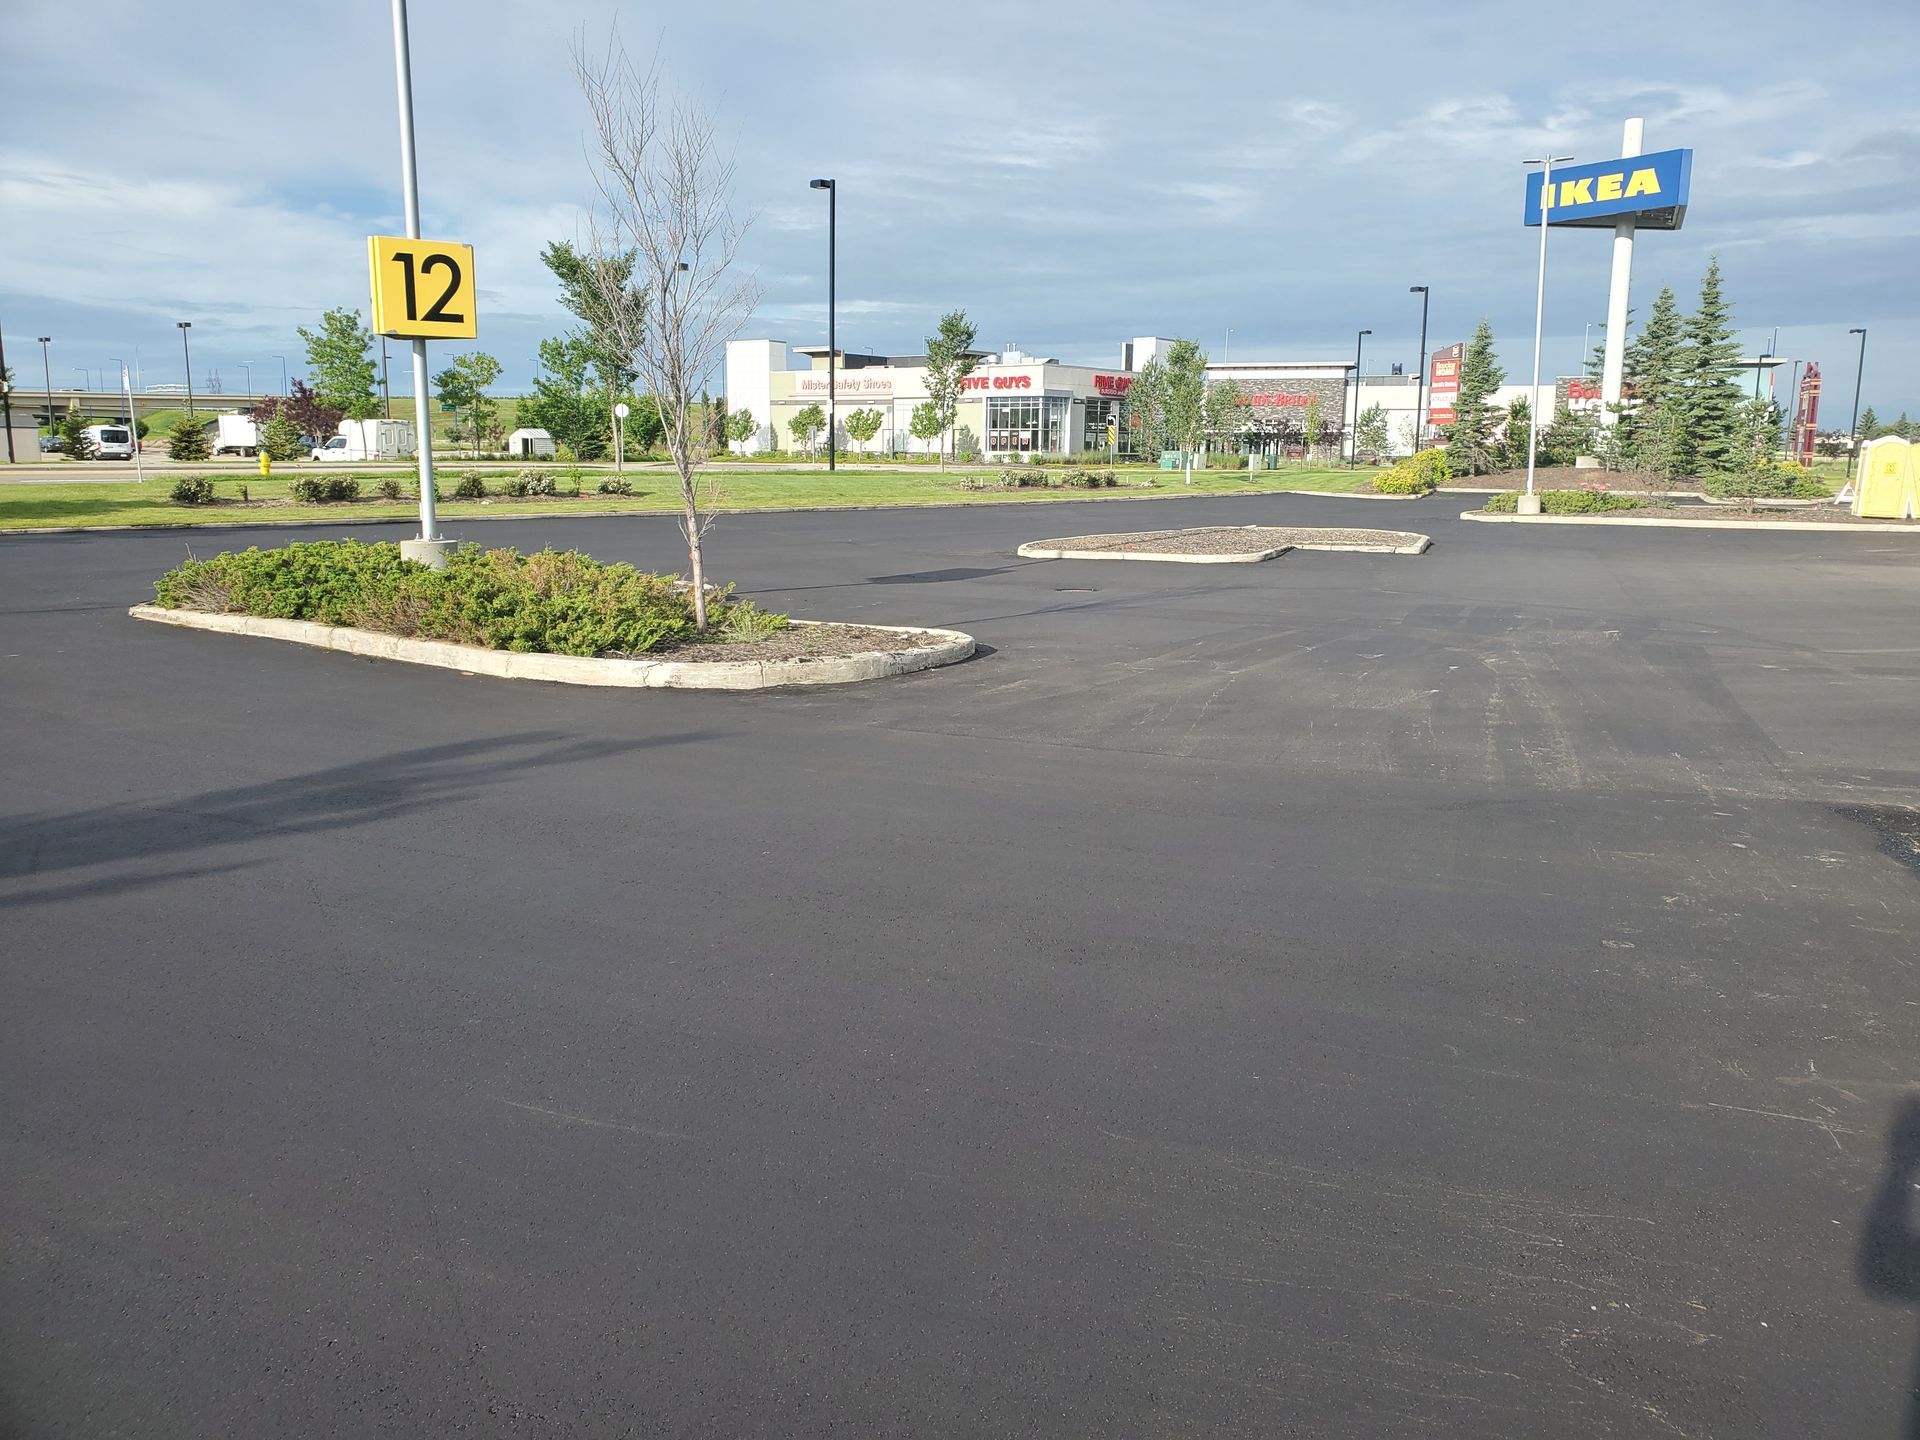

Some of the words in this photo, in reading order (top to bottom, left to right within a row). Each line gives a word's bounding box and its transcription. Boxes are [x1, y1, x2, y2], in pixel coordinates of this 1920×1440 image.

[1540, 168, 1661, 210] IKEA
[391, 252, 464, 323] 12
[863, 378, 892, 389] Shoes
[960, 377, 989, 389] FIVE
[993, 376, 1031, 389] GUYS
